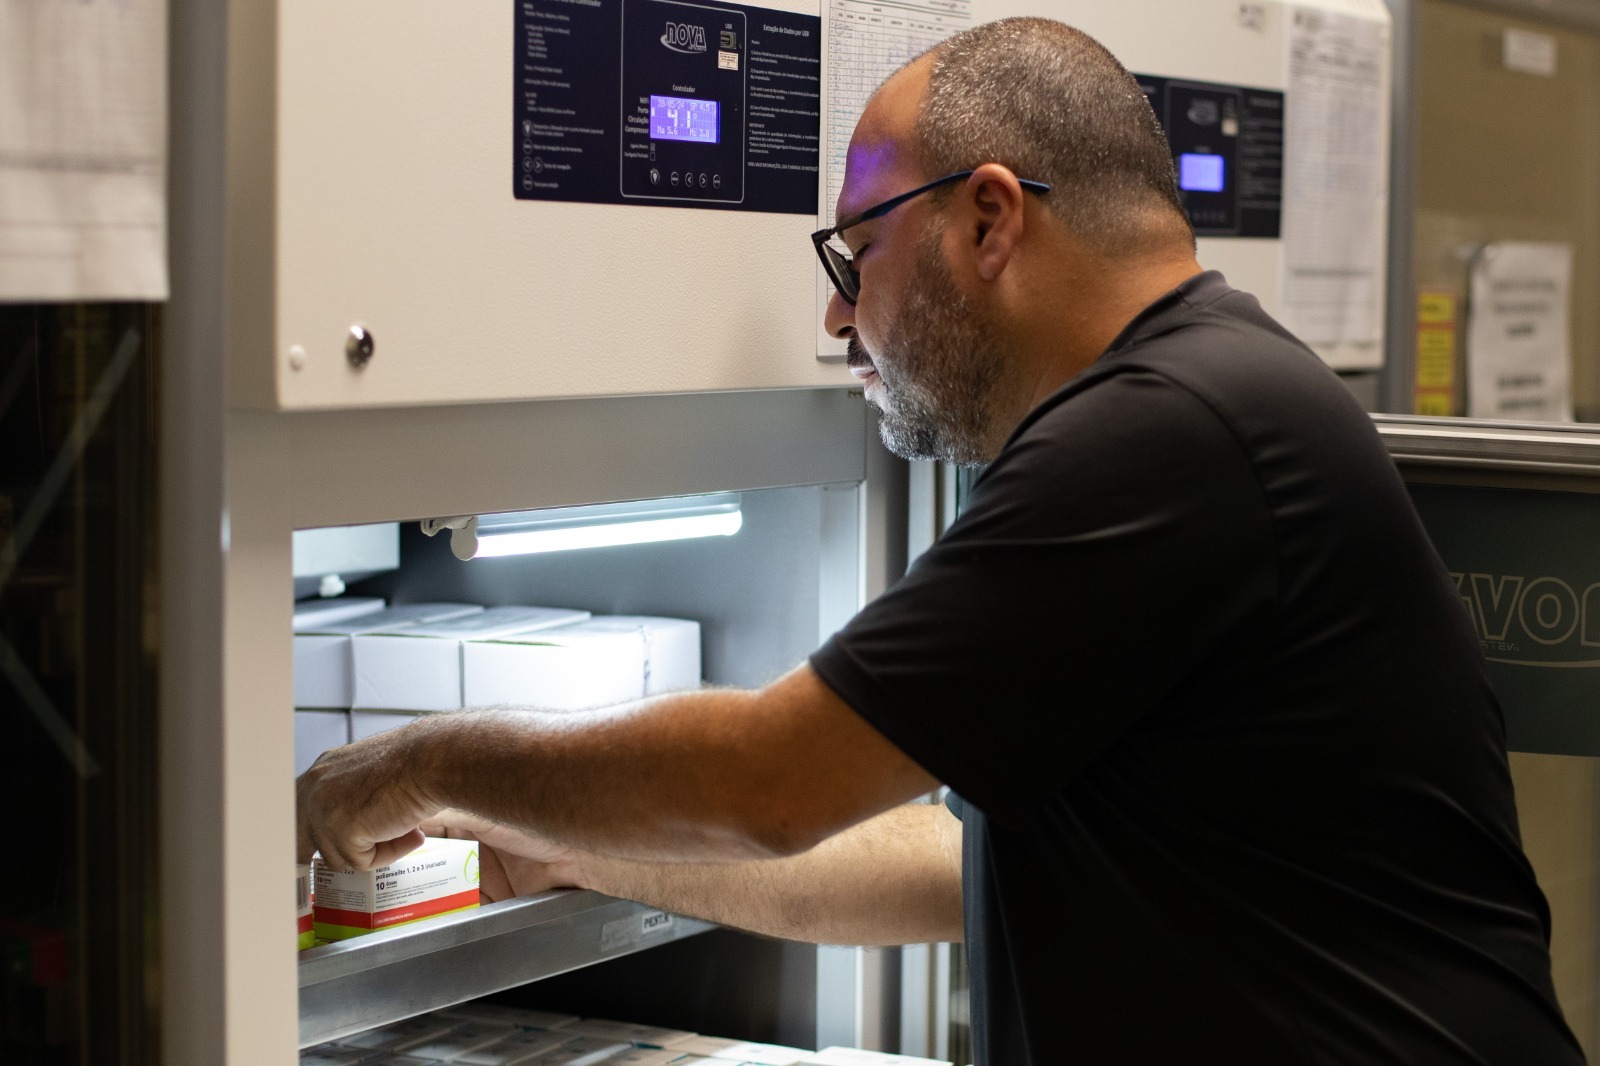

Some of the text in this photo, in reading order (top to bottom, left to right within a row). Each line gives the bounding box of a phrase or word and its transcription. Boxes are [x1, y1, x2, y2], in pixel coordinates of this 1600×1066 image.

[672, 84, 696, 93] Controlador
[637, 106, 649, 114] Porta
[627, 115, 649, 125] Circulação
[624, 125, 650, 135] Compressor
[667, 126, 678, 135] 5.6
[376, 882, 385, 891] 10
